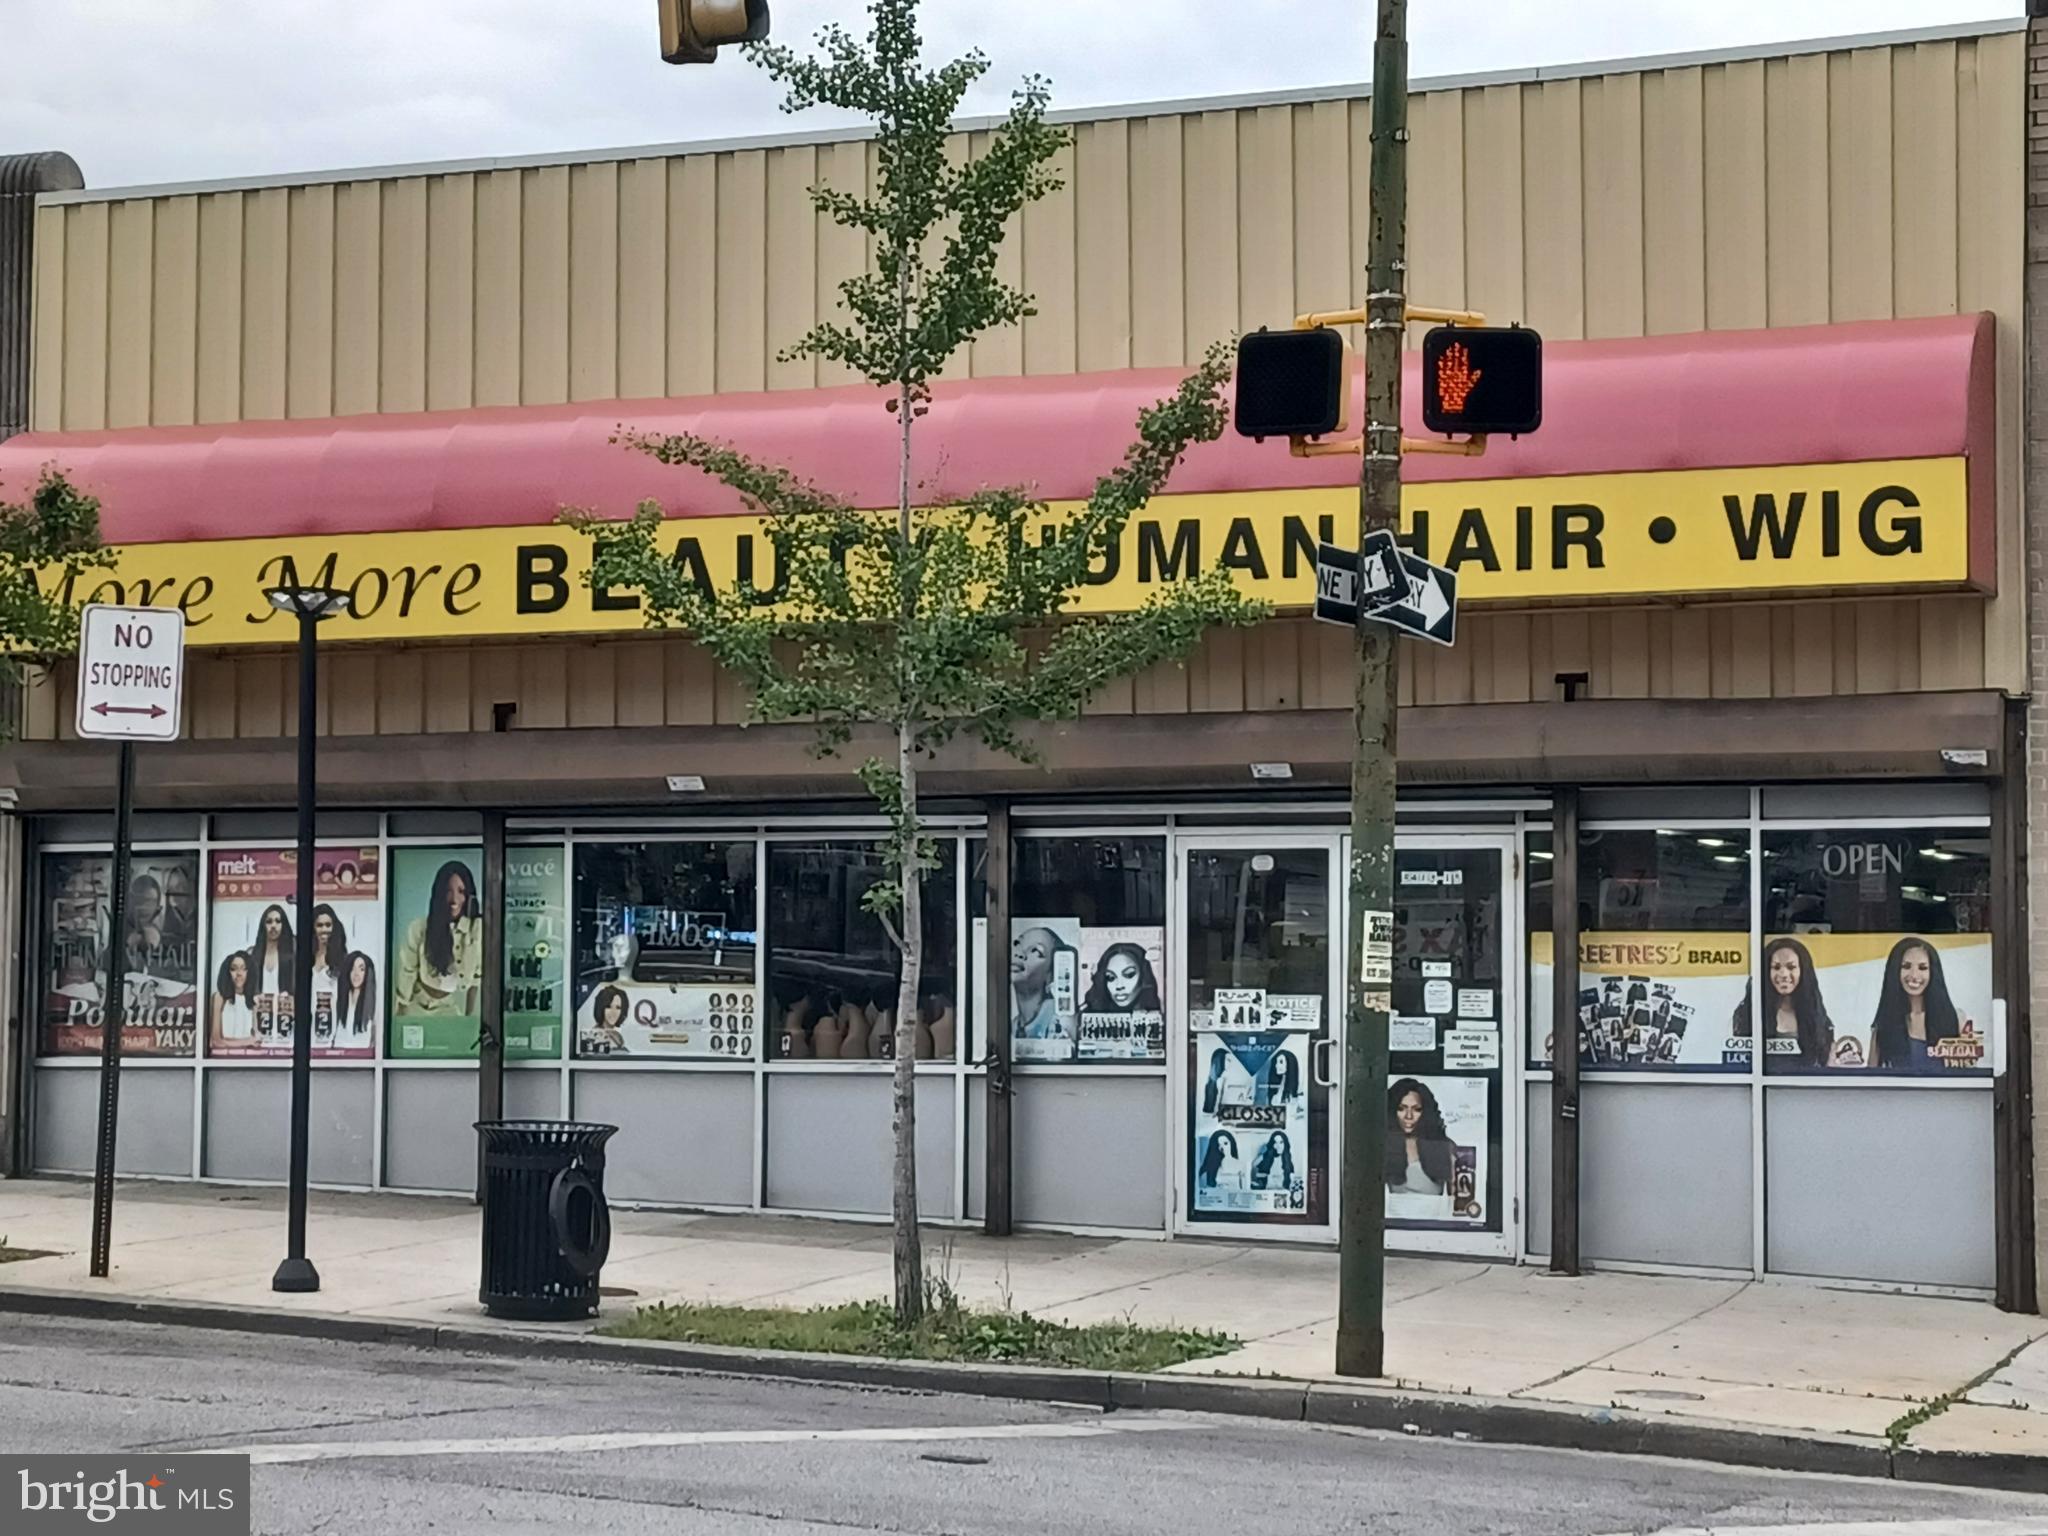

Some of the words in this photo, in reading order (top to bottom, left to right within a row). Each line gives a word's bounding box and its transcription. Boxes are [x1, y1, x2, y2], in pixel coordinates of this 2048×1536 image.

[246, 552, 481, 624] More
[1399, 504, 1606, 573] HAIR
[1723, 485, 1923, 560] WIG
[115, 624, 153, 649] NO
[90, 662, 172, 690] STOPPING
[217, 854, 257, 875] melt
[1823, 843, 1902, 876] OPEN
[1688, 950, 1742, 964] BRAID
[65, 999, 193, 1028] Poular
[154, 1029, 196, 1048] YAKY
[1220, 1105, 1284, 1122] GLOSSY
